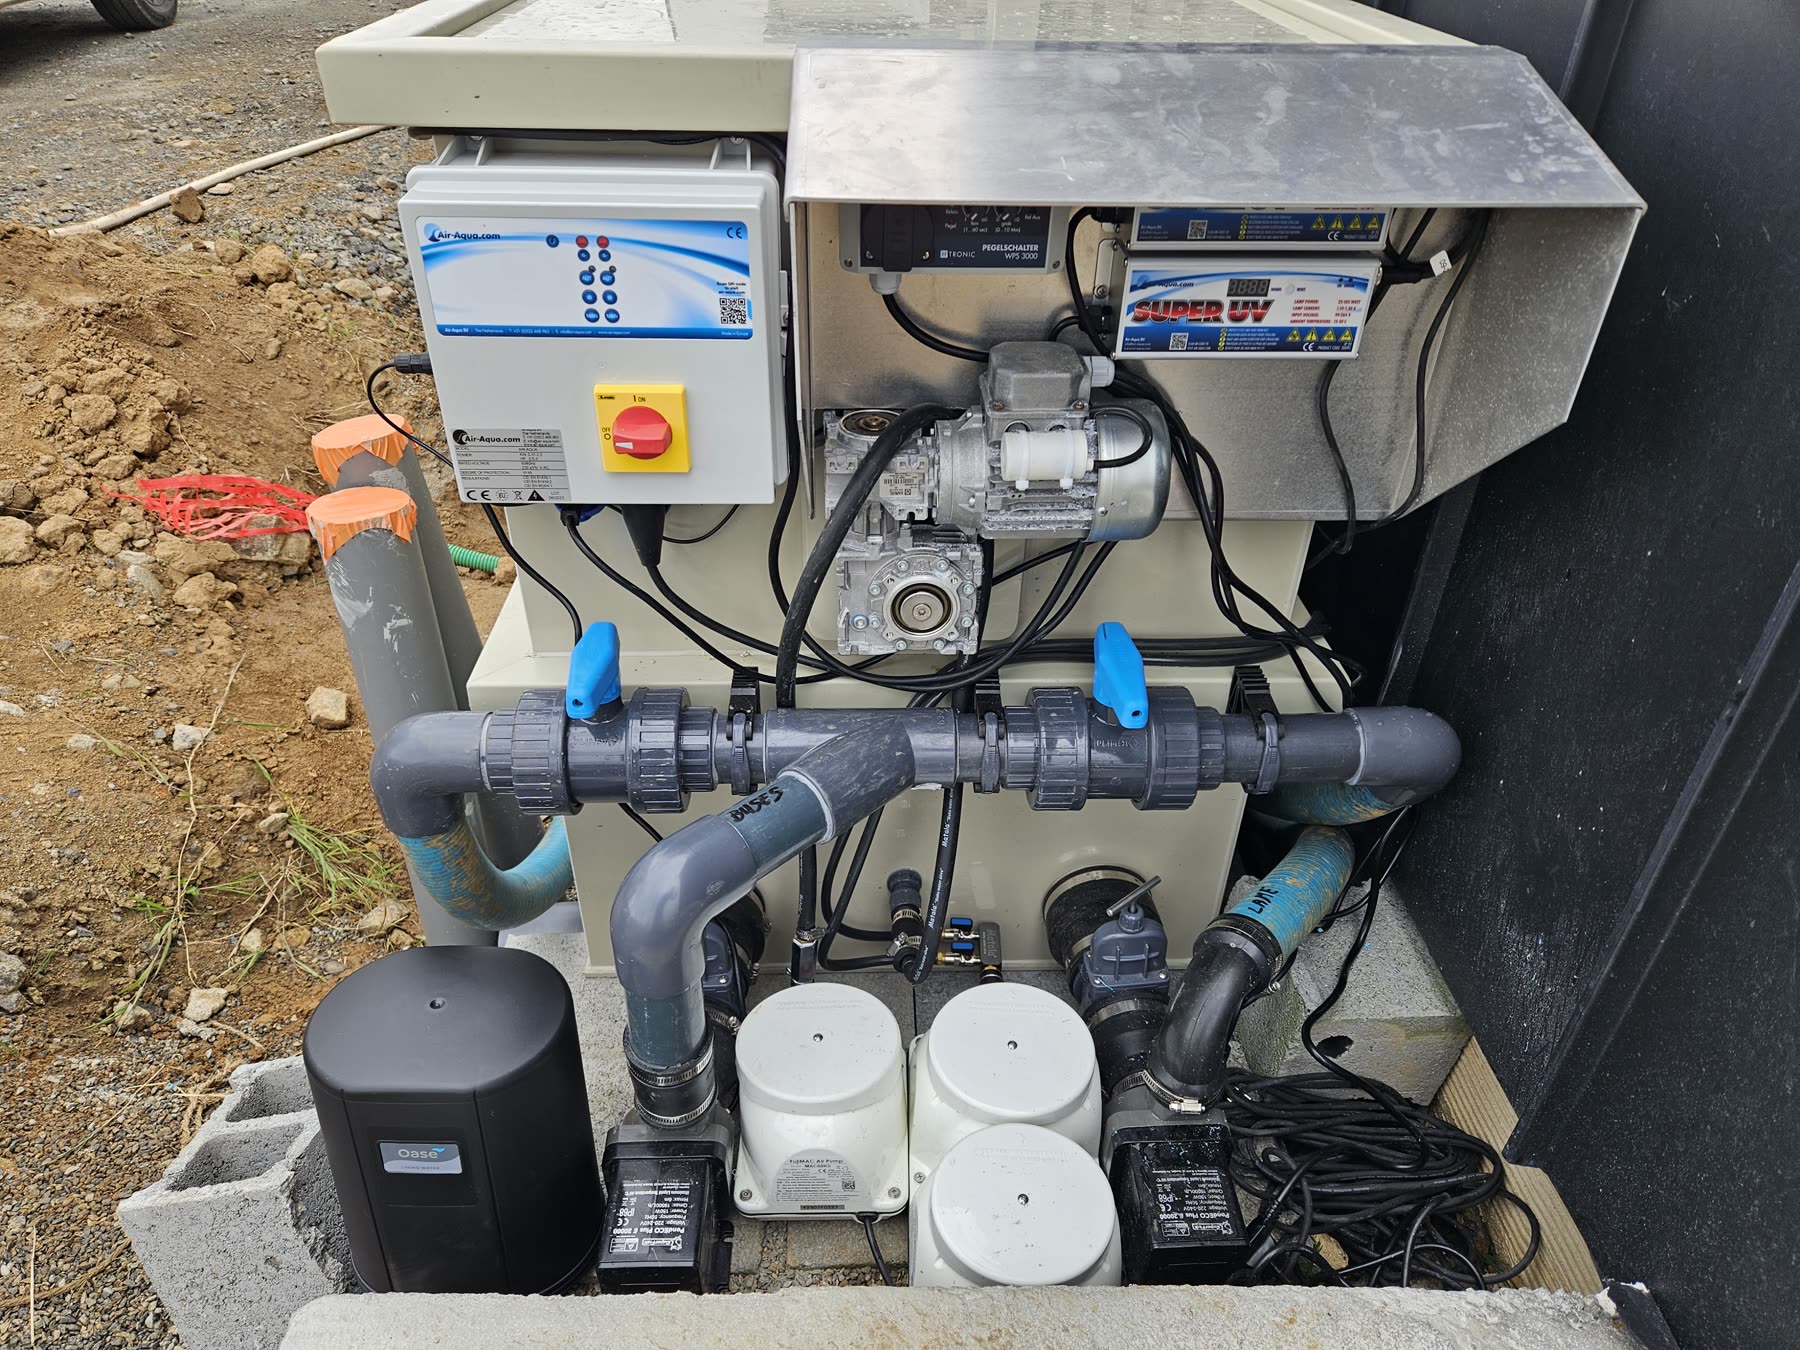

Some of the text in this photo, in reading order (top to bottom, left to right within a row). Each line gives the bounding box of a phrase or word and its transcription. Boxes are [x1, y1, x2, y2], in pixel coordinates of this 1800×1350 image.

[437, 231, 501, 241] Air-Aqua.com
[1131, 299, 1275, 324] SUPER UV
[465, 435, 521, 443] Air-Aqua.com
[729, 786, 784, 822] BUSES
[398, 1148, 438, 1159] Oase
[619, 1207, 635, 1217] IP68
